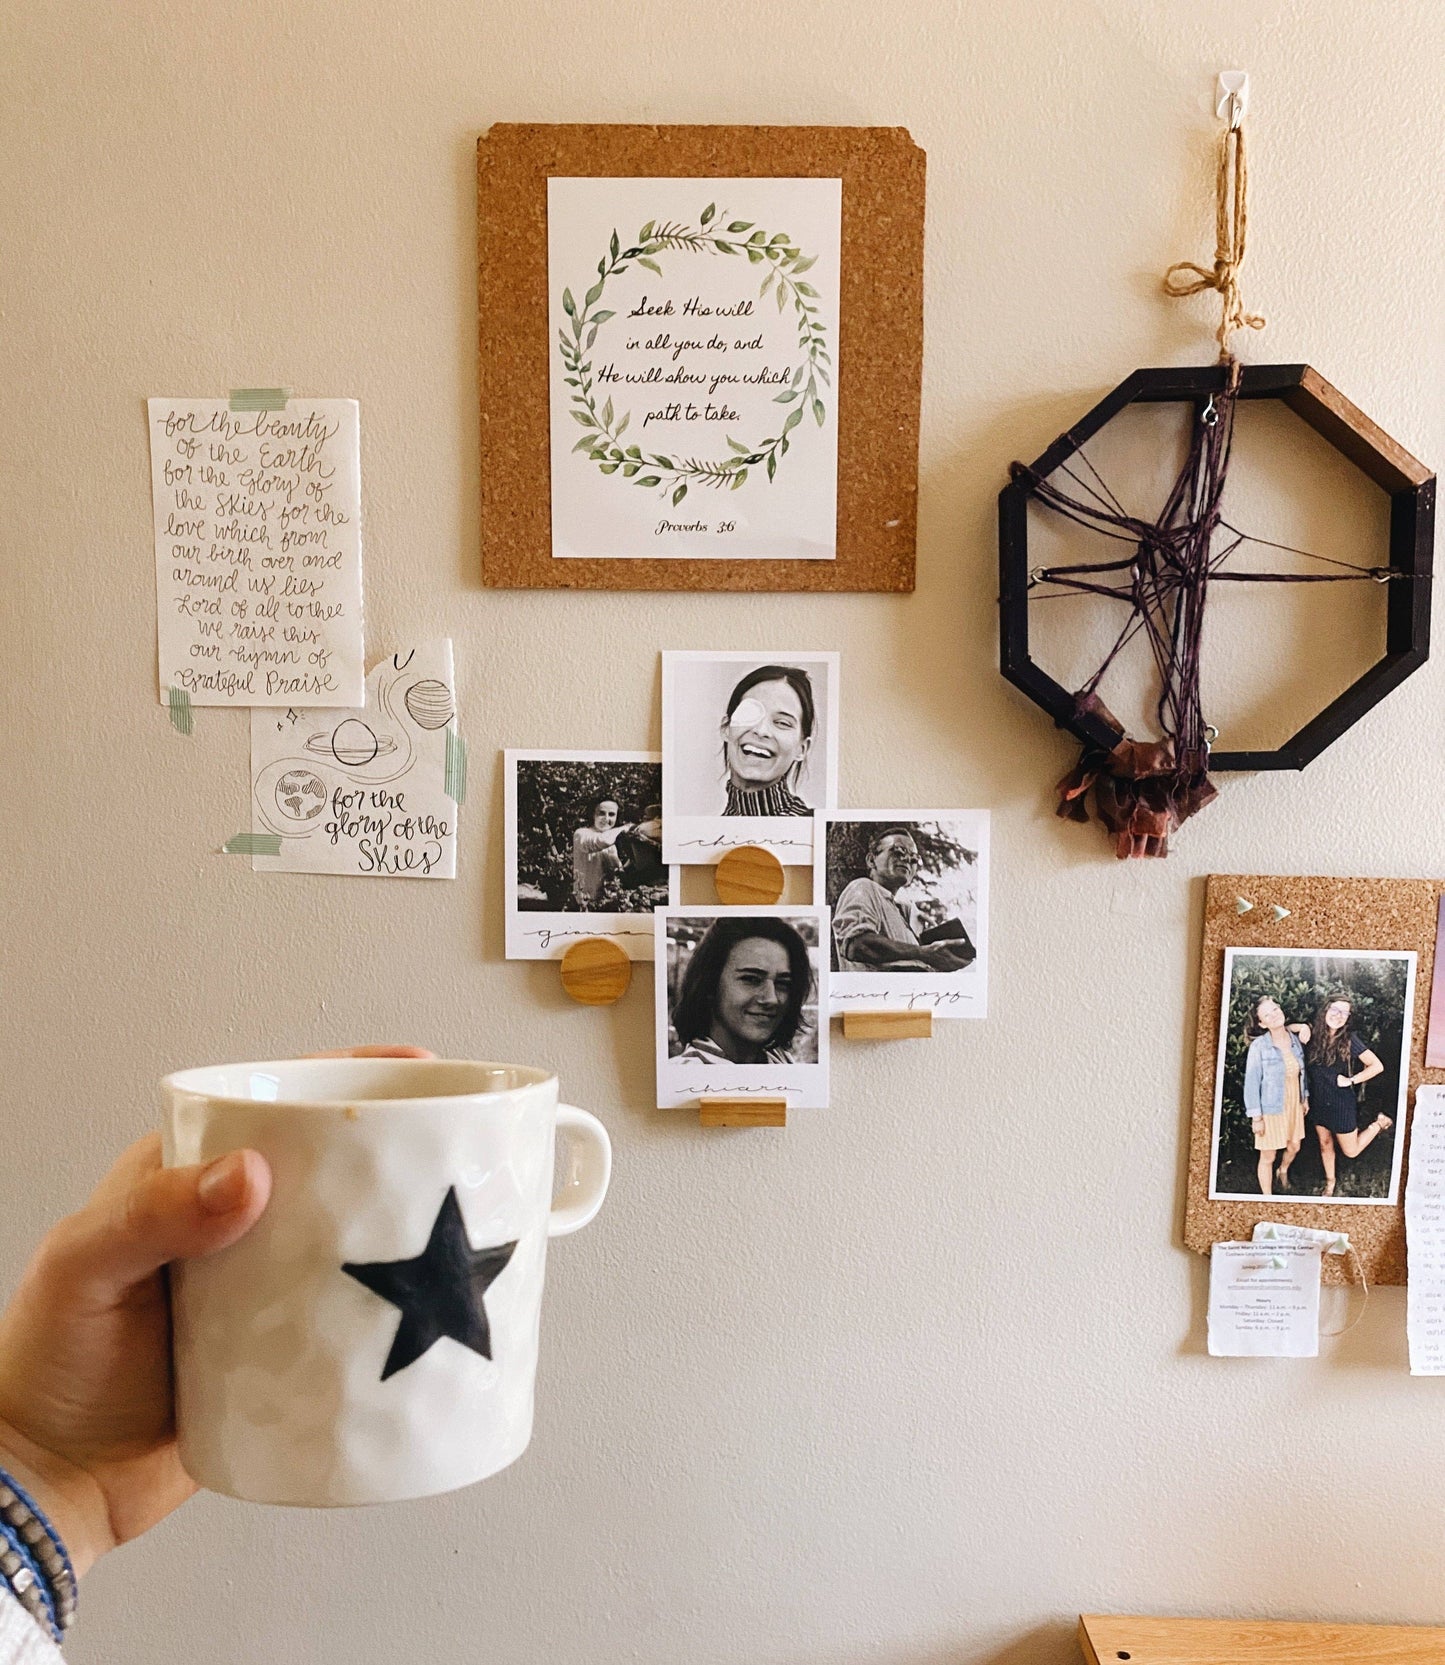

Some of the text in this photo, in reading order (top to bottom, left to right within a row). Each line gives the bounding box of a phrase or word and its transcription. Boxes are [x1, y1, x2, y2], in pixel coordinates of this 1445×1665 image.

[627, 297, 754, 318] Seek His will
[626, 337, 640, 350] in
[645, 334, 673, 350] all
[673, 342, 703, 360] you
[734, 334, 763, 350] and
[598, 363, 791, 394] He will show you which
[643, 402, 740, 428] path to take.
[157, 410, 339, 453] for the beauty
[176, 437, 335, 478] of the Earth
[164, 459, 192, 486] for
[198, 467, 230, 487] the
[305, 482, 333, 502] of
[175, 489, 206, 510] the
[280, 504, 310, 529] for
[314, 503, 349, 526] the
[164, 513, 328, 551] love which from
[654, 520, 708, 535] Proverbs
[172, 543, 342, 572] our birth over and
[172, 568, 324, 596] around us lies
[174, 595, 345, 622] Lord of all to thee
[229, 621, 275, 643] raise
[283, 626, 321, 644] this
[189, 644, 333, 669] our hymn of
[174, 668, 338, 696] Grateful Praise
[331, 786, 407, 819] for the
[325, 811, 452, 845] glory of the
[678, 835, 813, 848] chiara
[675, 1083, 803, 1093] chiara
